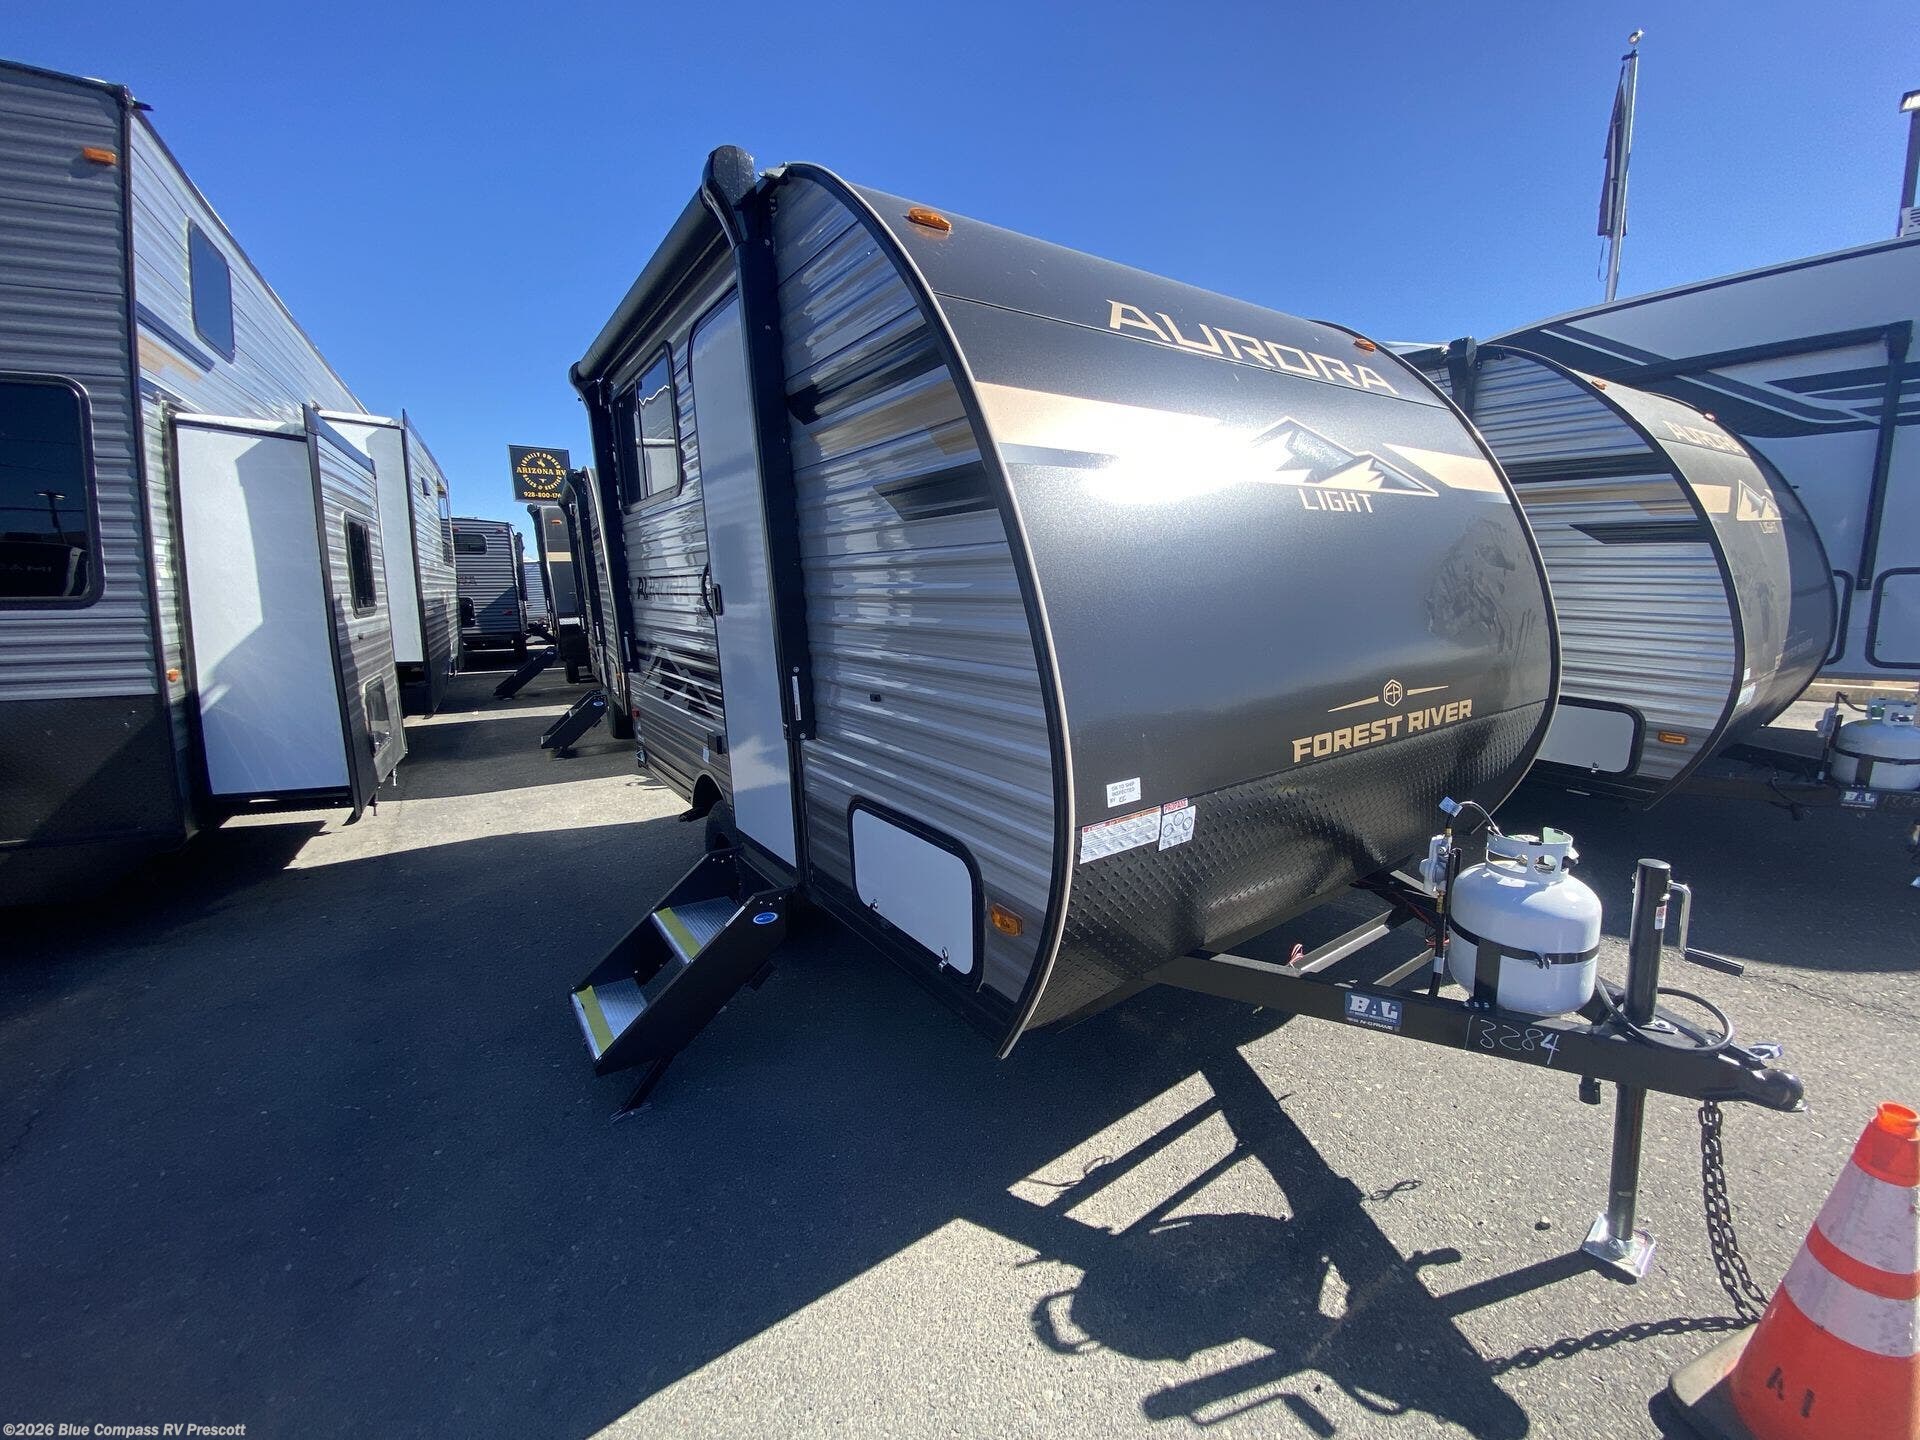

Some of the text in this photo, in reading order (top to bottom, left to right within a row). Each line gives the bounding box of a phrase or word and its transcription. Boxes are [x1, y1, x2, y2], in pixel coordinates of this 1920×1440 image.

[1106, 299, 1399, 395] AURORA
[517, 467, 554, 475] ARIZONA
[1298, 488, 1373, 513] LIGHT
[1292, 699, 1473, 763] FOREST RIVER
[1163, 800, 1187, 813] PROPANE
[1350, 994, 1398, 1019] BAL
